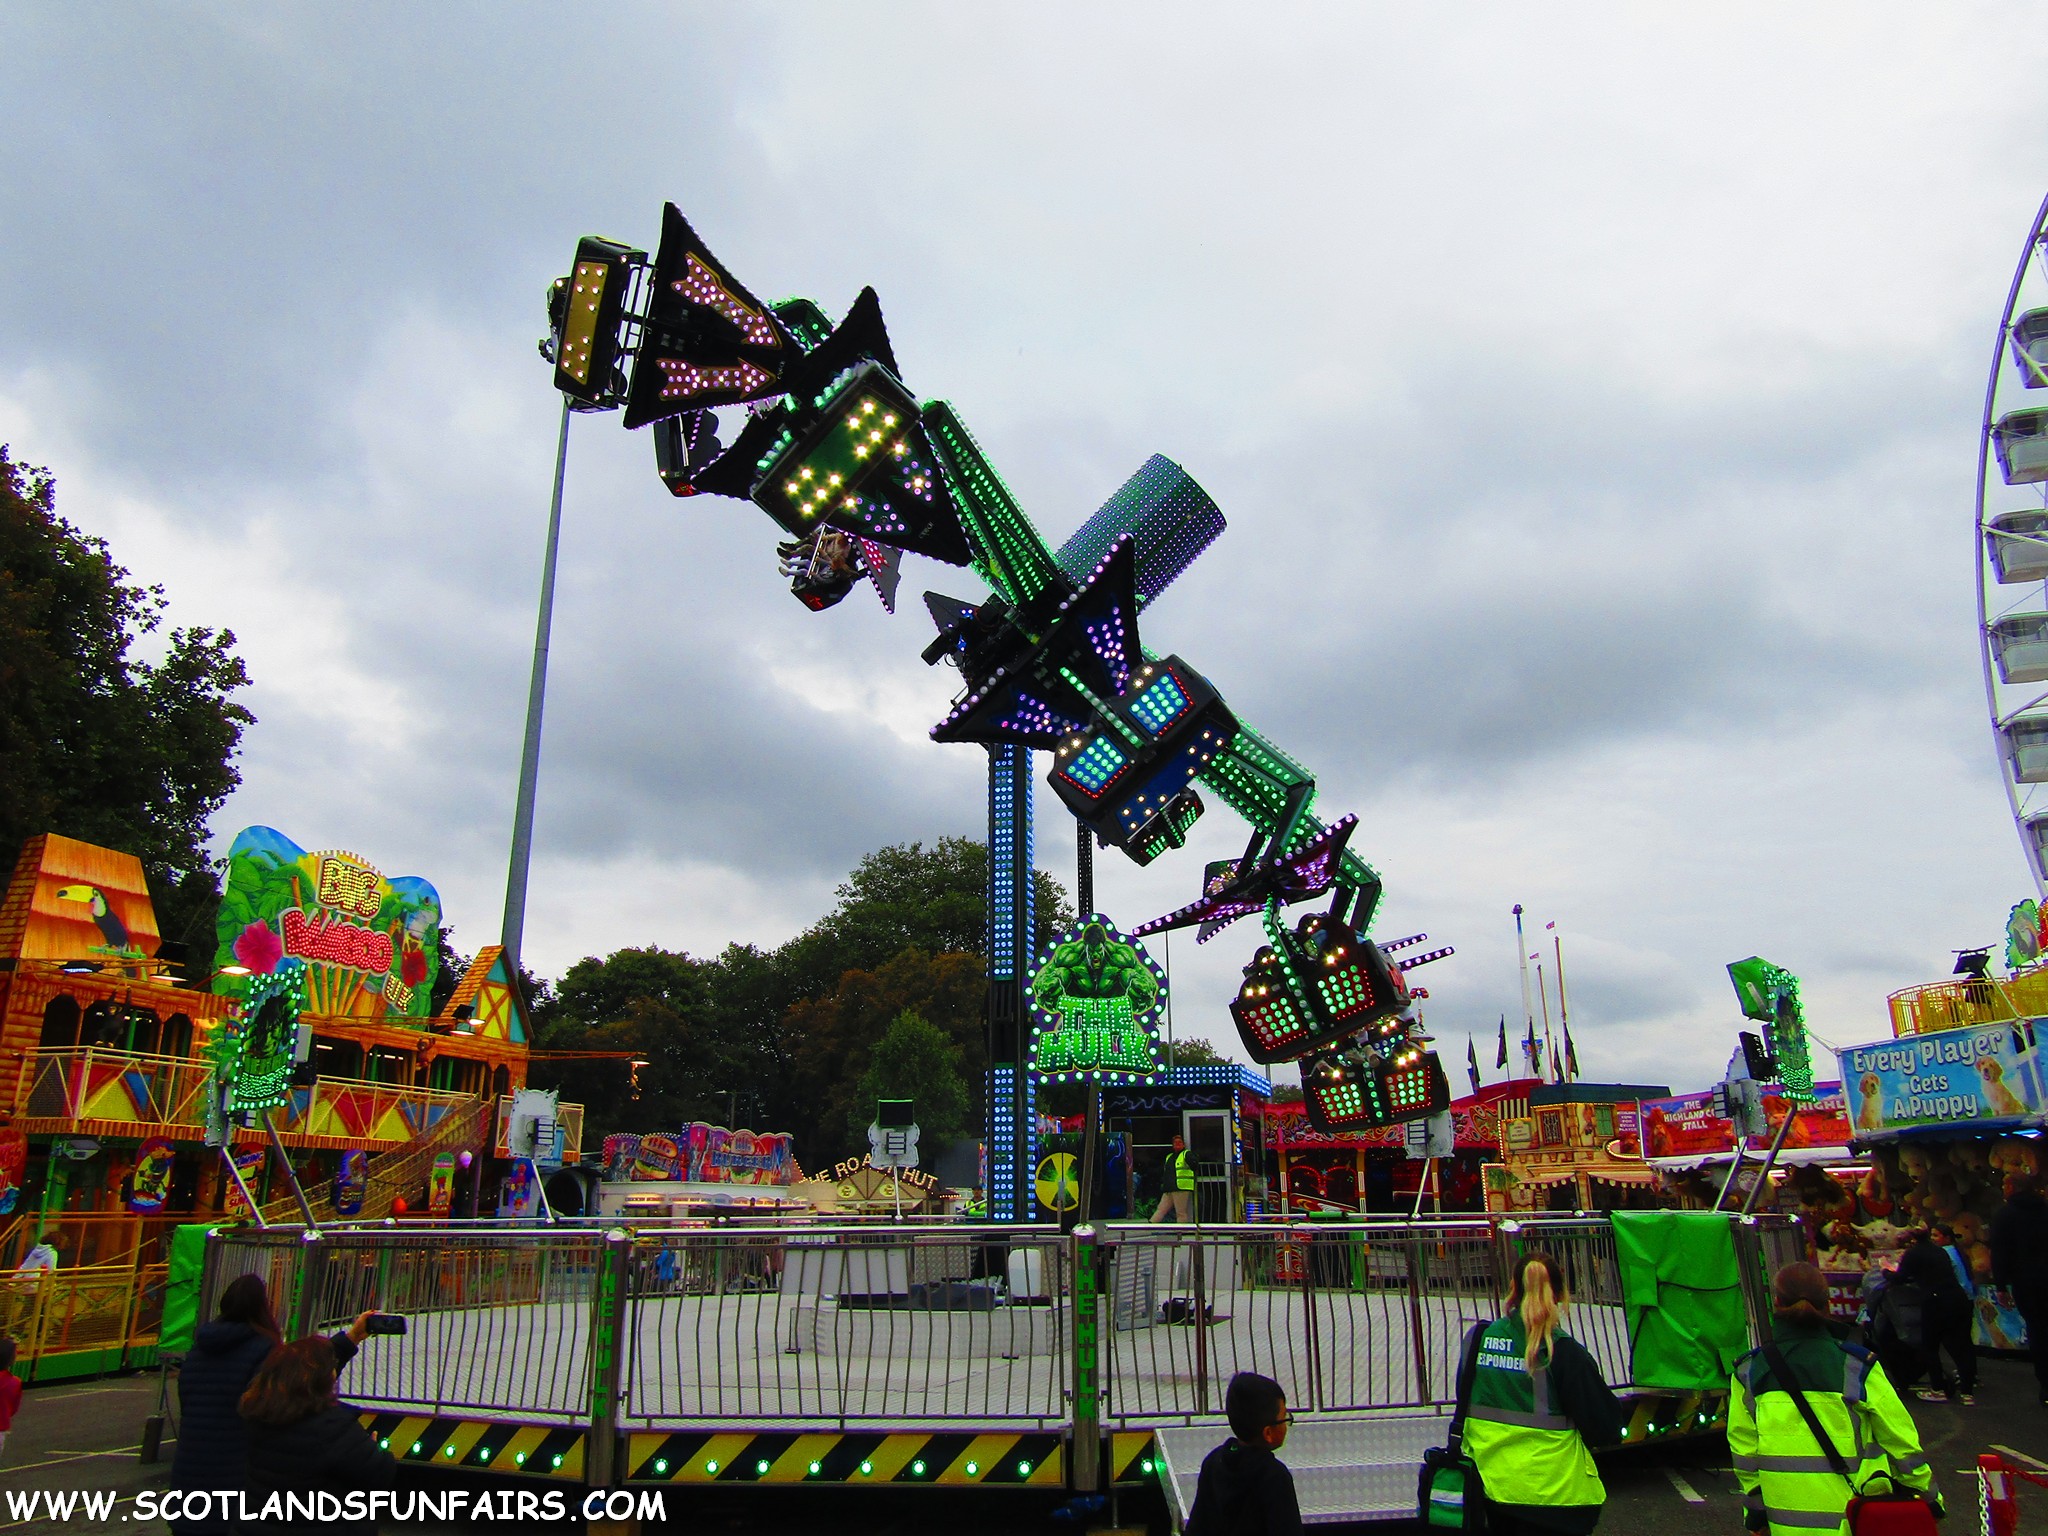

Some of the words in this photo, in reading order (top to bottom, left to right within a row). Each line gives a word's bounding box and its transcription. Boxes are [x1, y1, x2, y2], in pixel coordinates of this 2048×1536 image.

[320, 858, 381, 916] BIG
[283, 910, 393, 974] BAMBOO
[1057, 996, 1134, 1032] THE
[1037, 1031, 1156, 1073] HULK
[1853, 1049, 1916, 1075] Every
[1920, 1031, 2003, 1066] Player
[1909, 1074, 1949, 1094] Gets
[1663, 1110, 1705, 1122] HIGHLAND
[1683, 1100, 1701, 1110] THE
[1893, 1098, 1907, 1119] A
[1908, 1094, 1979, 1120] Puppy
[1682, 1119, 1708, 1131] STALL
[649, 1137, 674, 1156] BIG
[711, 1150, 774, 1170] BURGER
[902, 1166, 938, 1190] HUT
[600, 1251, 617, 1317] THE
[1077, 1245, 1095, 1315] THE
[1483, 1336, 1513, 1352] FIRST
[593, 1323, 613, 1417] HULK
[1078, 1322, 1096, 1419] HULK
[1476, 1352, 1526, 1371] ESPONDER
